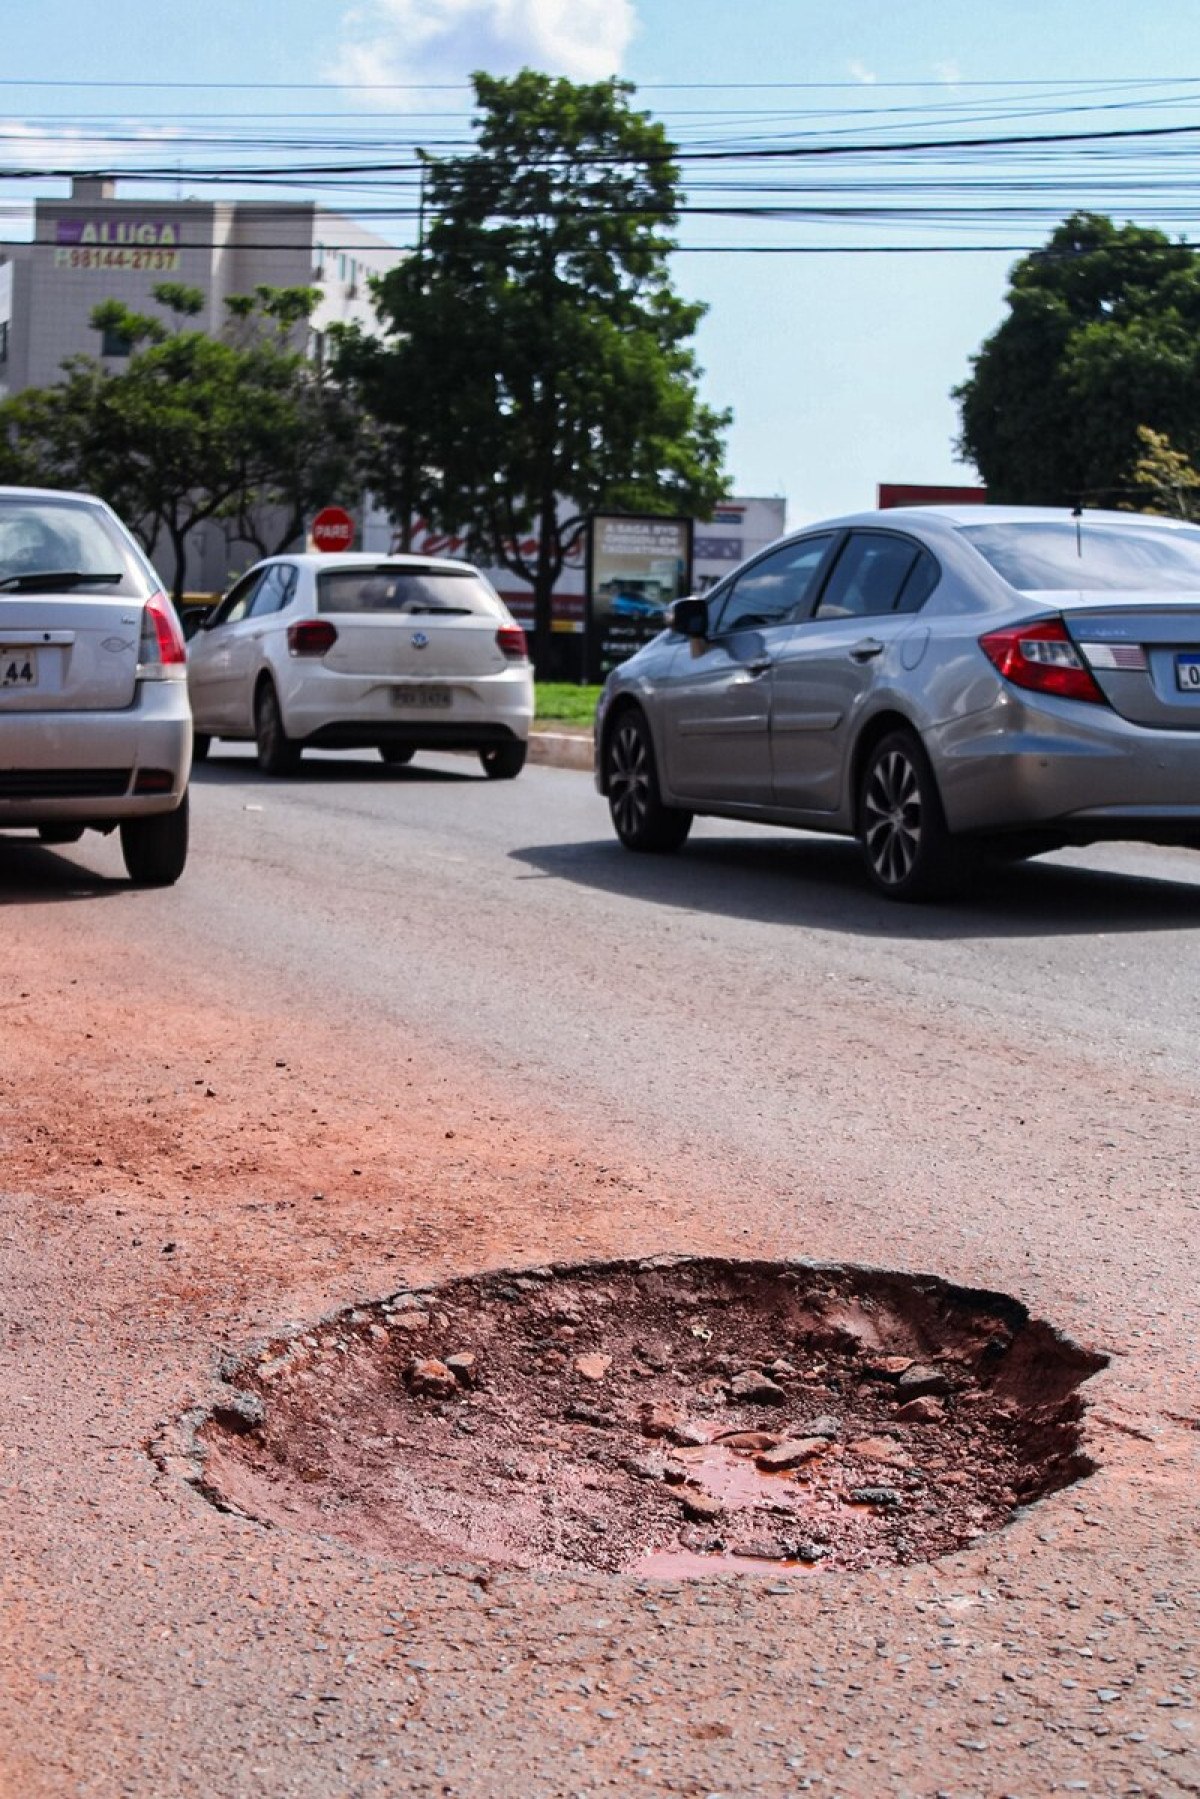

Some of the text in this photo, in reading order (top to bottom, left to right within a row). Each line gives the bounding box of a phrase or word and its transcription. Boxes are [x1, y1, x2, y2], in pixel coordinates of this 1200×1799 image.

[80, 222, 176, 244] ALUGA
[71, 249, 176, 269] 98144-2737
[314, 524, 349, 538] PARE
[6, 661, 33, 682] 44
